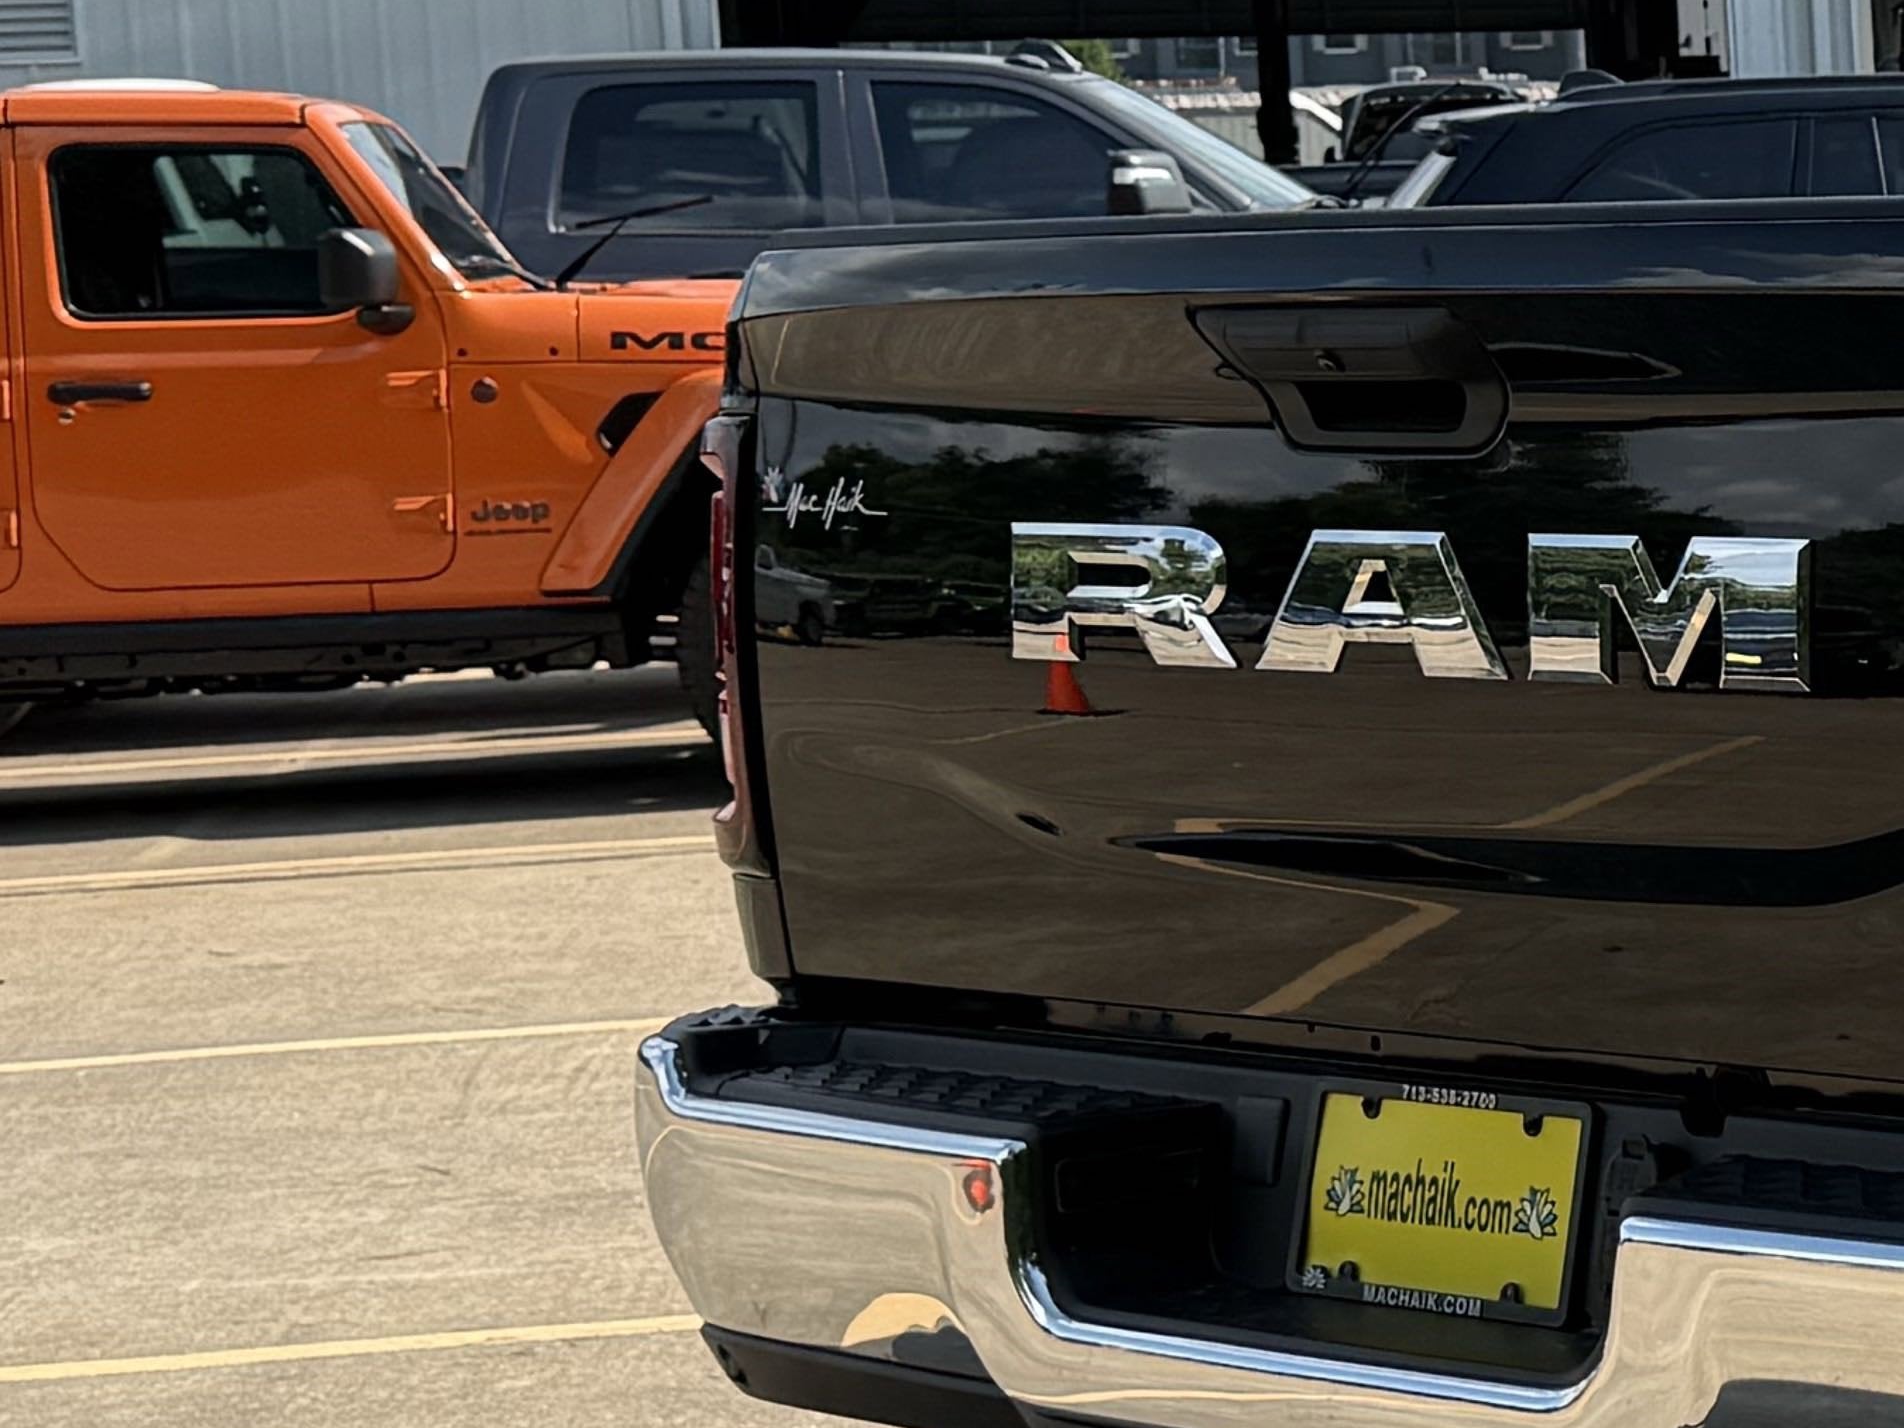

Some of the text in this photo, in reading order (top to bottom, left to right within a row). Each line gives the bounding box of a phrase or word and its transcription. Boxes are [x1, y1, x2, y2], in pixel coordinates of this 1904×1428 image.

[470, 499, 550, 524] Jeep
[1010, 521, 1812, 692] RAM
[1367, 1157, 1513, 1235] machaik.com
[1362, 1283, 1483, 1318] MACHAIK.COM
